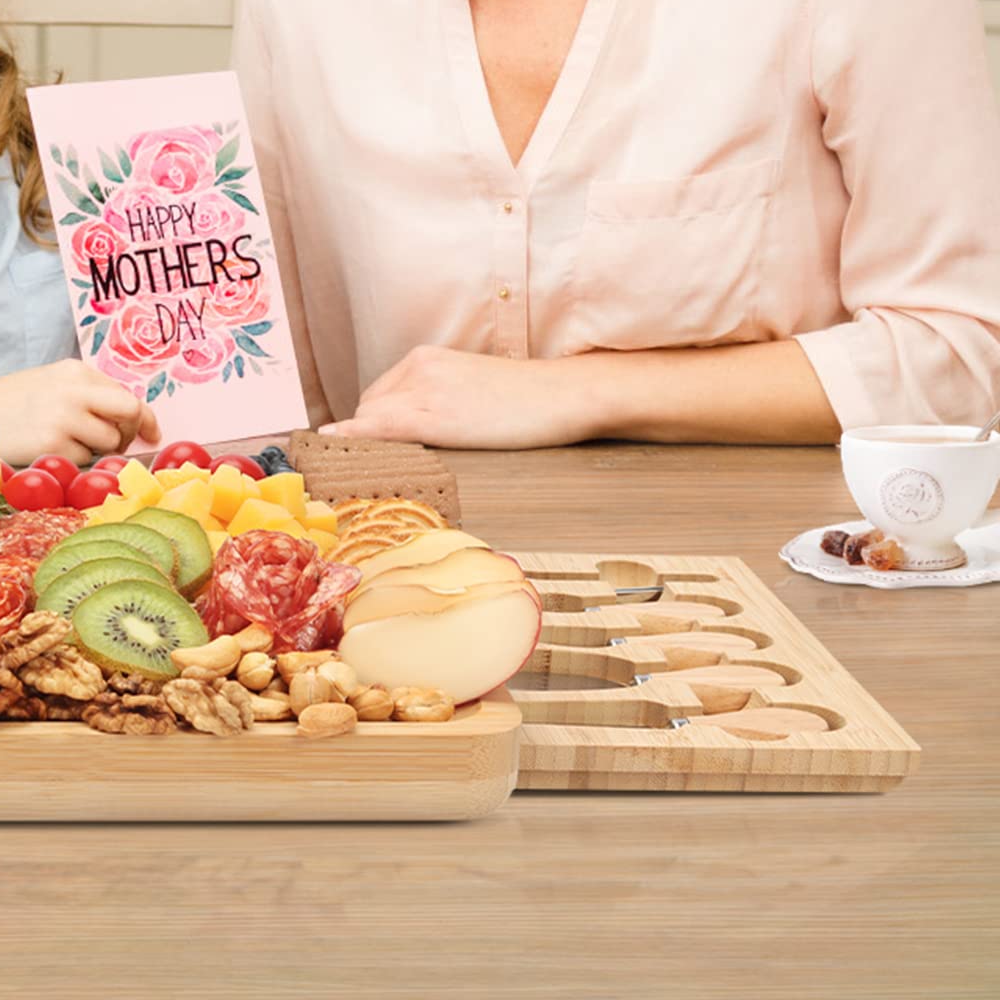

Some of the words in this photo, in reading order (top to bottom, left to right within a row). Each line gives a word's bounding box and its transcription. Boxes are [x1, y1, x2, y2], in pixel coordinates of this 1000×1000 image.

[125, 202, 197, 242] HAPPY
[89, 234, 261, 302] MOTHERS
[155, 297, 207, 344] DAY
